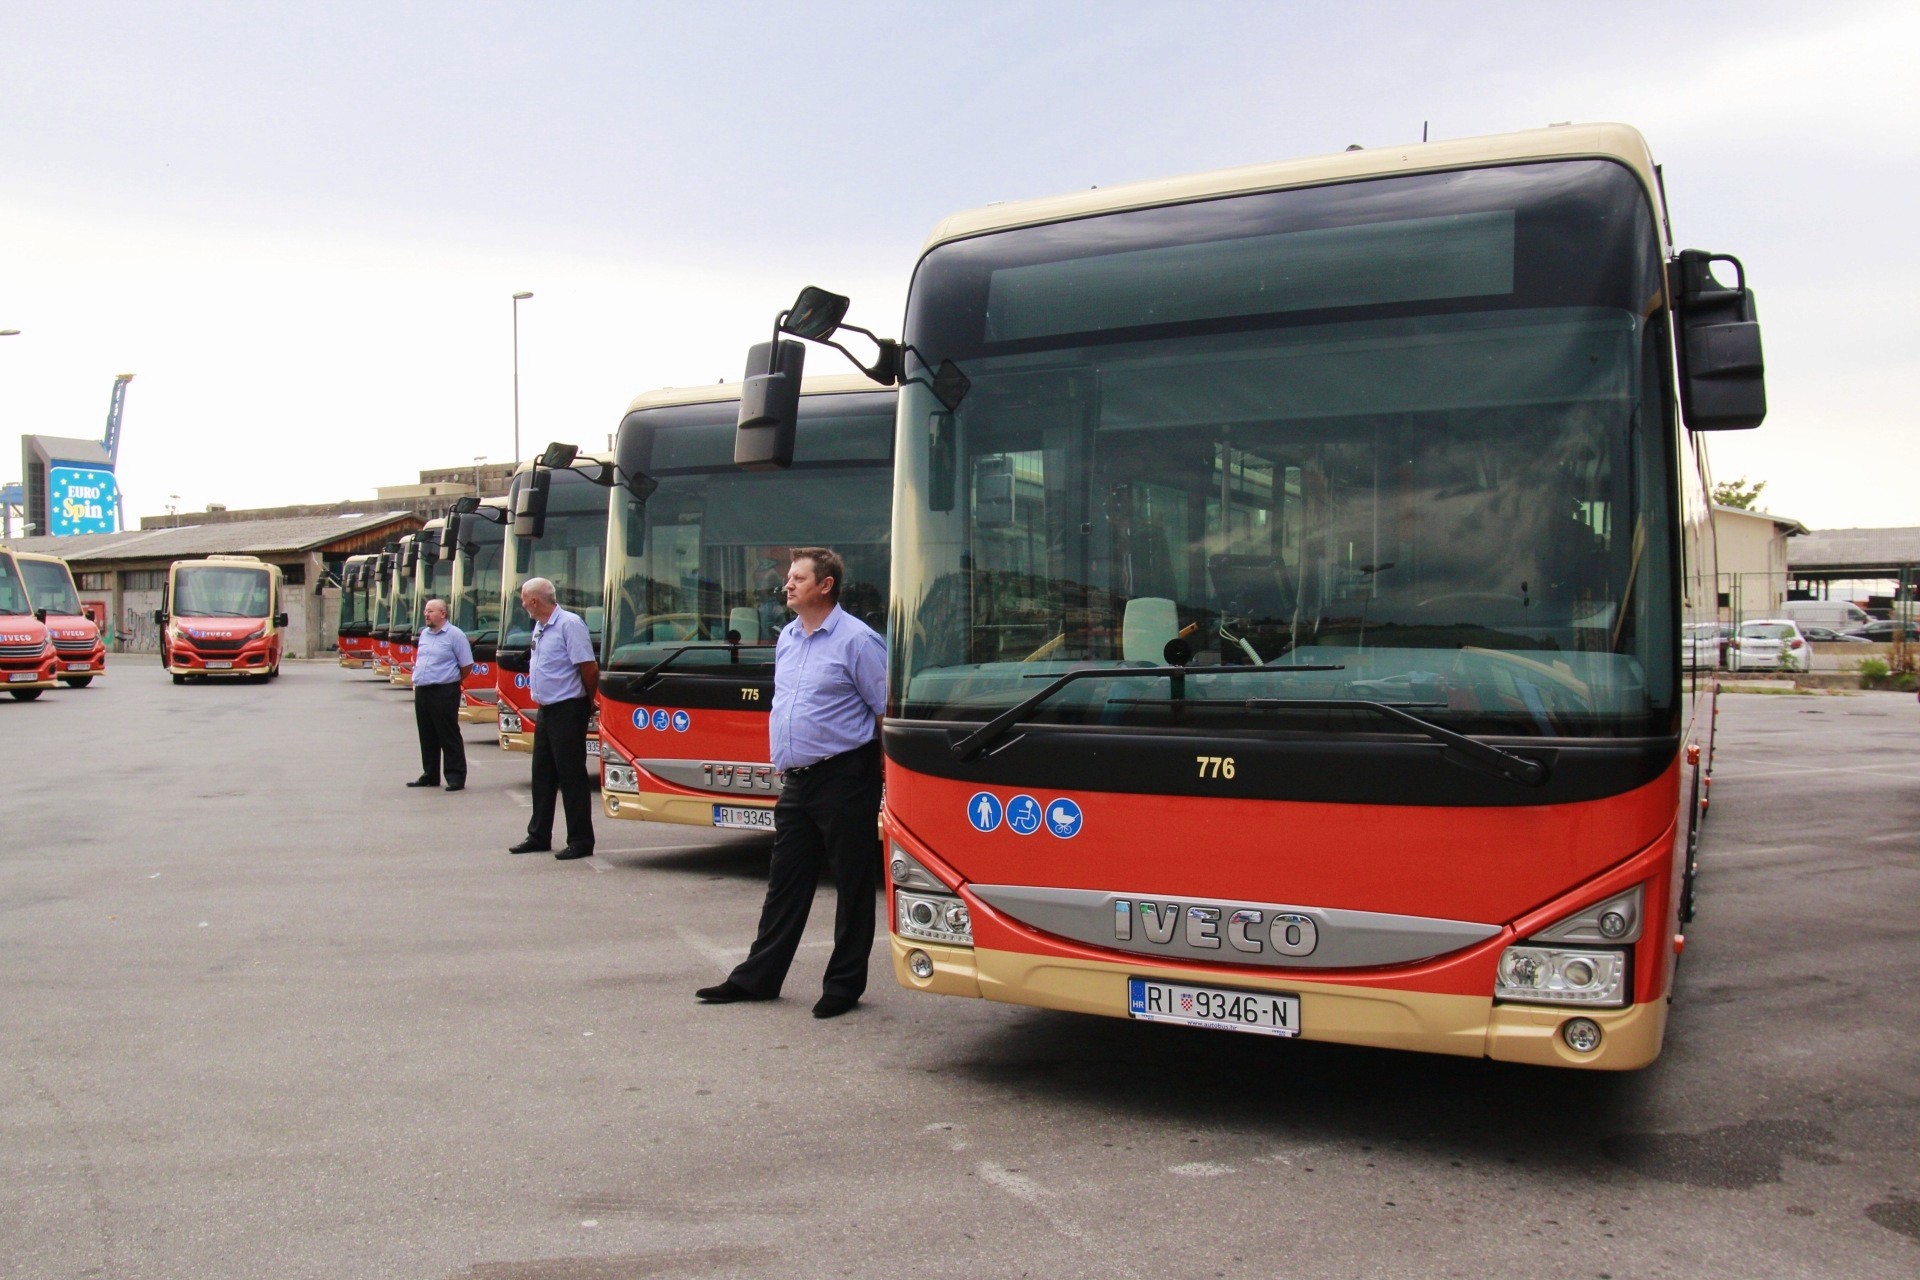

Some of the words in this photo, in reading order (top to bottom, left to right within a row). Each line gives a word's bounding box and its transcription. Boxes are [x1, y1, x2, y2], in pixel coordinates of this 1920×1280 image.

[68, 486, 100, 499] EURO
[63, 497, 103, 523] Spin
[4, 634, 32, 642] IVECO
[741, 688, 760, 700] 775
[1197, 756, 1236, 779] 776
[721, 808, 734, 823] RI
[1115, 899, 1319, 957] IVECO
[1132, 1000, 1145, 1009] HR
[1148, 986, 1173, 1013] RI
[1196, 991, 1287, 1027] 9346-N
[1187, 1020, 1237, 1030] www.autobus.hr
